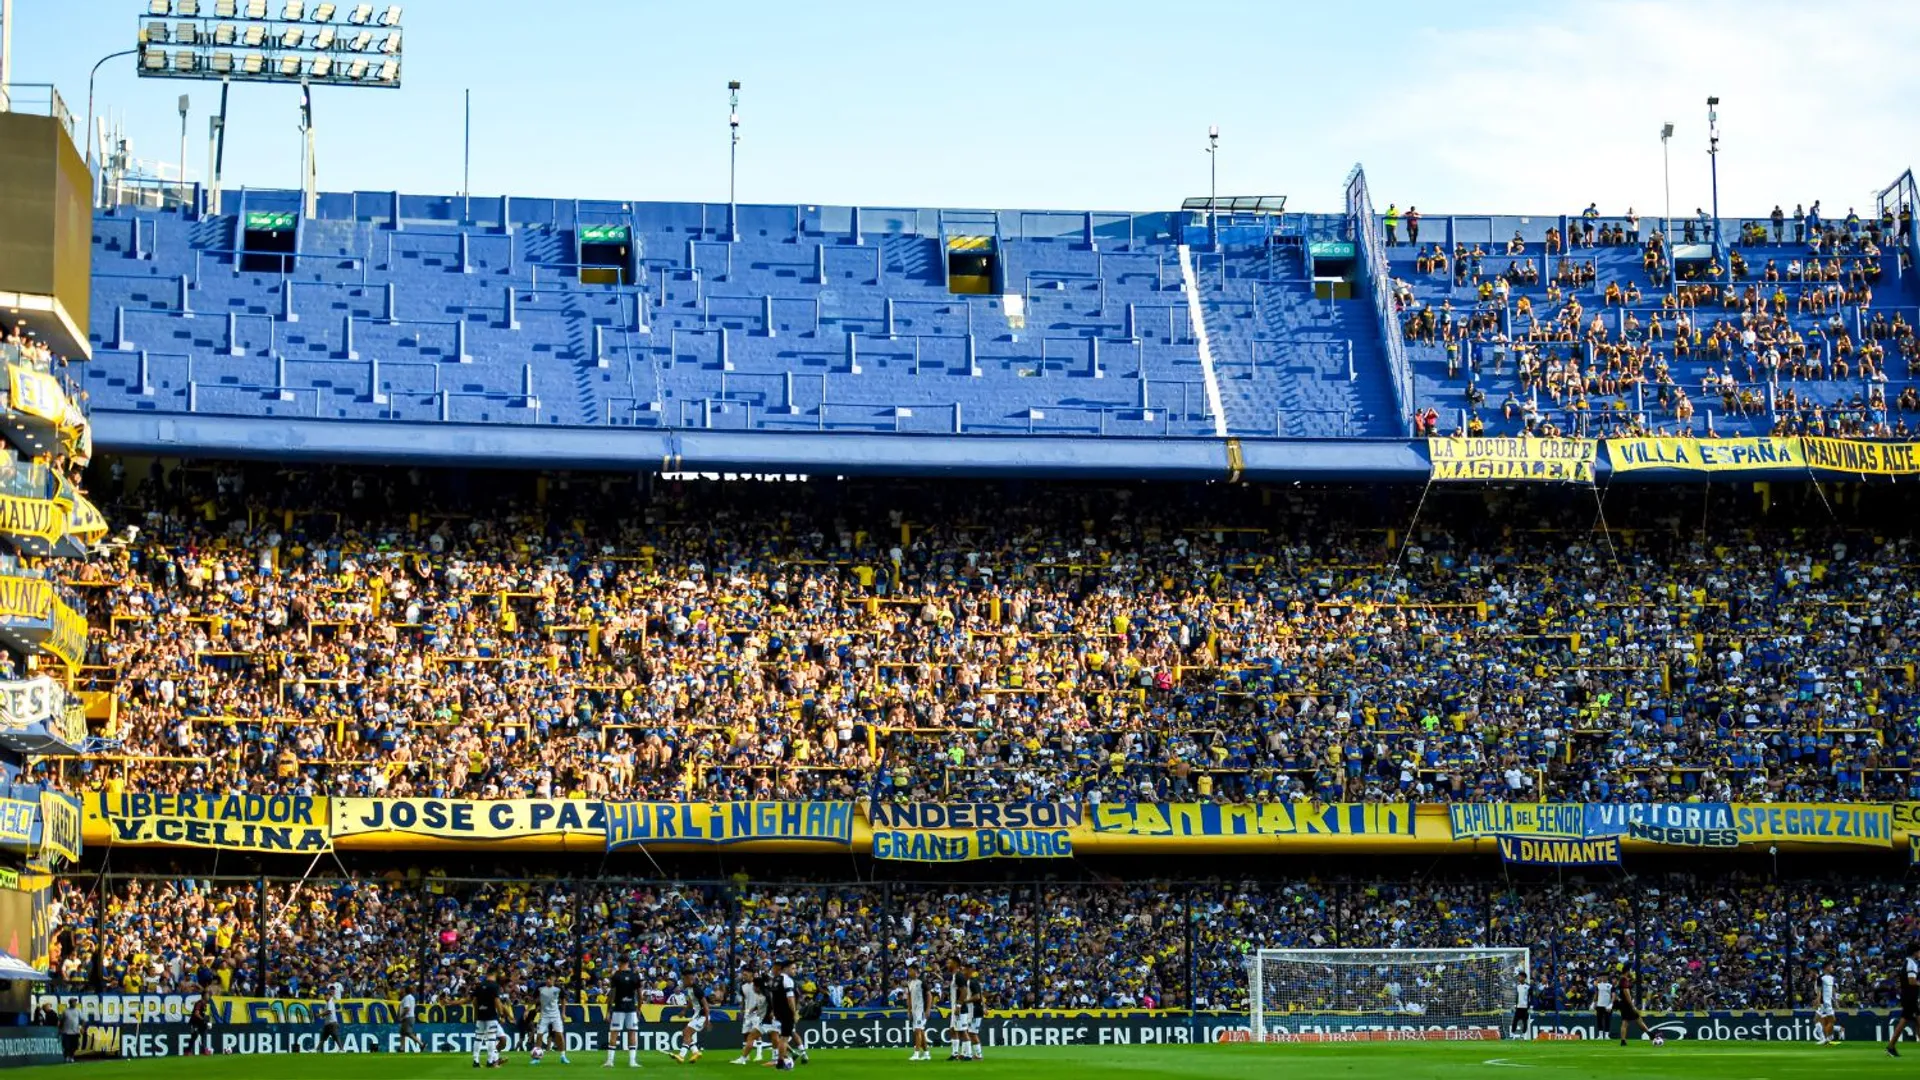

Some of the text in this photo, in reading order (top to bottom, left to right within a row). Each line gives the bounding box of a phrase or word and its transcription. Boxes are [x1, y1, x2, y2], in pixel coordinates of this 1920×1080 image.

[1433, 439, 1592, 458] LA LOCURA CRECE
[1620, 444, 1690, 464] VILLA
[1805, 437, 1878, 470] MALVINAS
[1432, 460, 1594, 483] MAGDALENA
[360, 801, 475, 831] JOSE
[869, 802, 1083, 828] ANDERSON
[1099, 802, 1204, 835] SAN
[1451, 804, 1514, 834] CAPILLA
[1516, 811, 1534, 825] DEL
[1600, 803, 1728, 828] VICTORIA
[1739, 807, 1890, 840] SPEGAZZINI
[872, 830, 1073, 860] GRAND BOURG
[1630, 823, 1739, 846] NOGUES
[1521, 841, 1618, 863] DIAMANTE
[566, 1032, 598, 1052] DE
